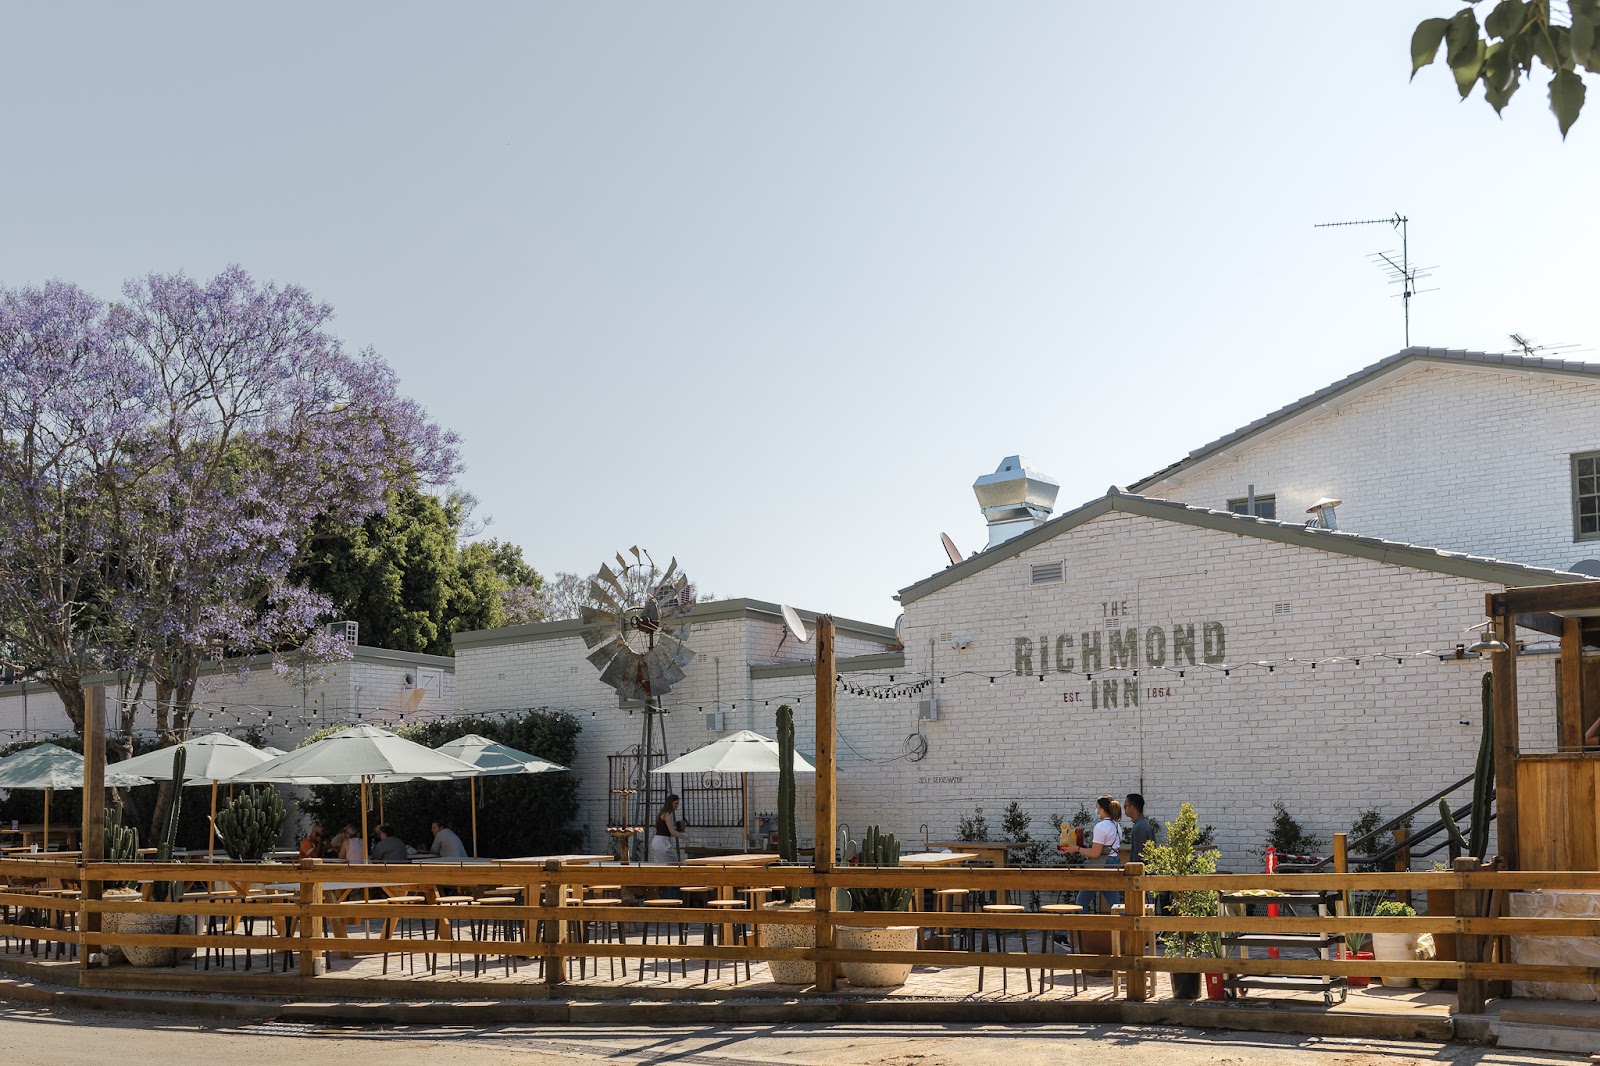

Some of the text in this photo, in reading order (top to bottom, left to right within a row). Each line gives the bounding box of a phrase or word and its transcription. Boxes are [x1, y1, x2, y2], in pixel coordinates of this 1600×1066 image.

[1102, 601, 1128, 617] THE
[1014, 621, 1226, 676] RICHMOND
[1063, 688, 1171, 702] EST. 1864
[1091, 677, 1139, 709] INN
